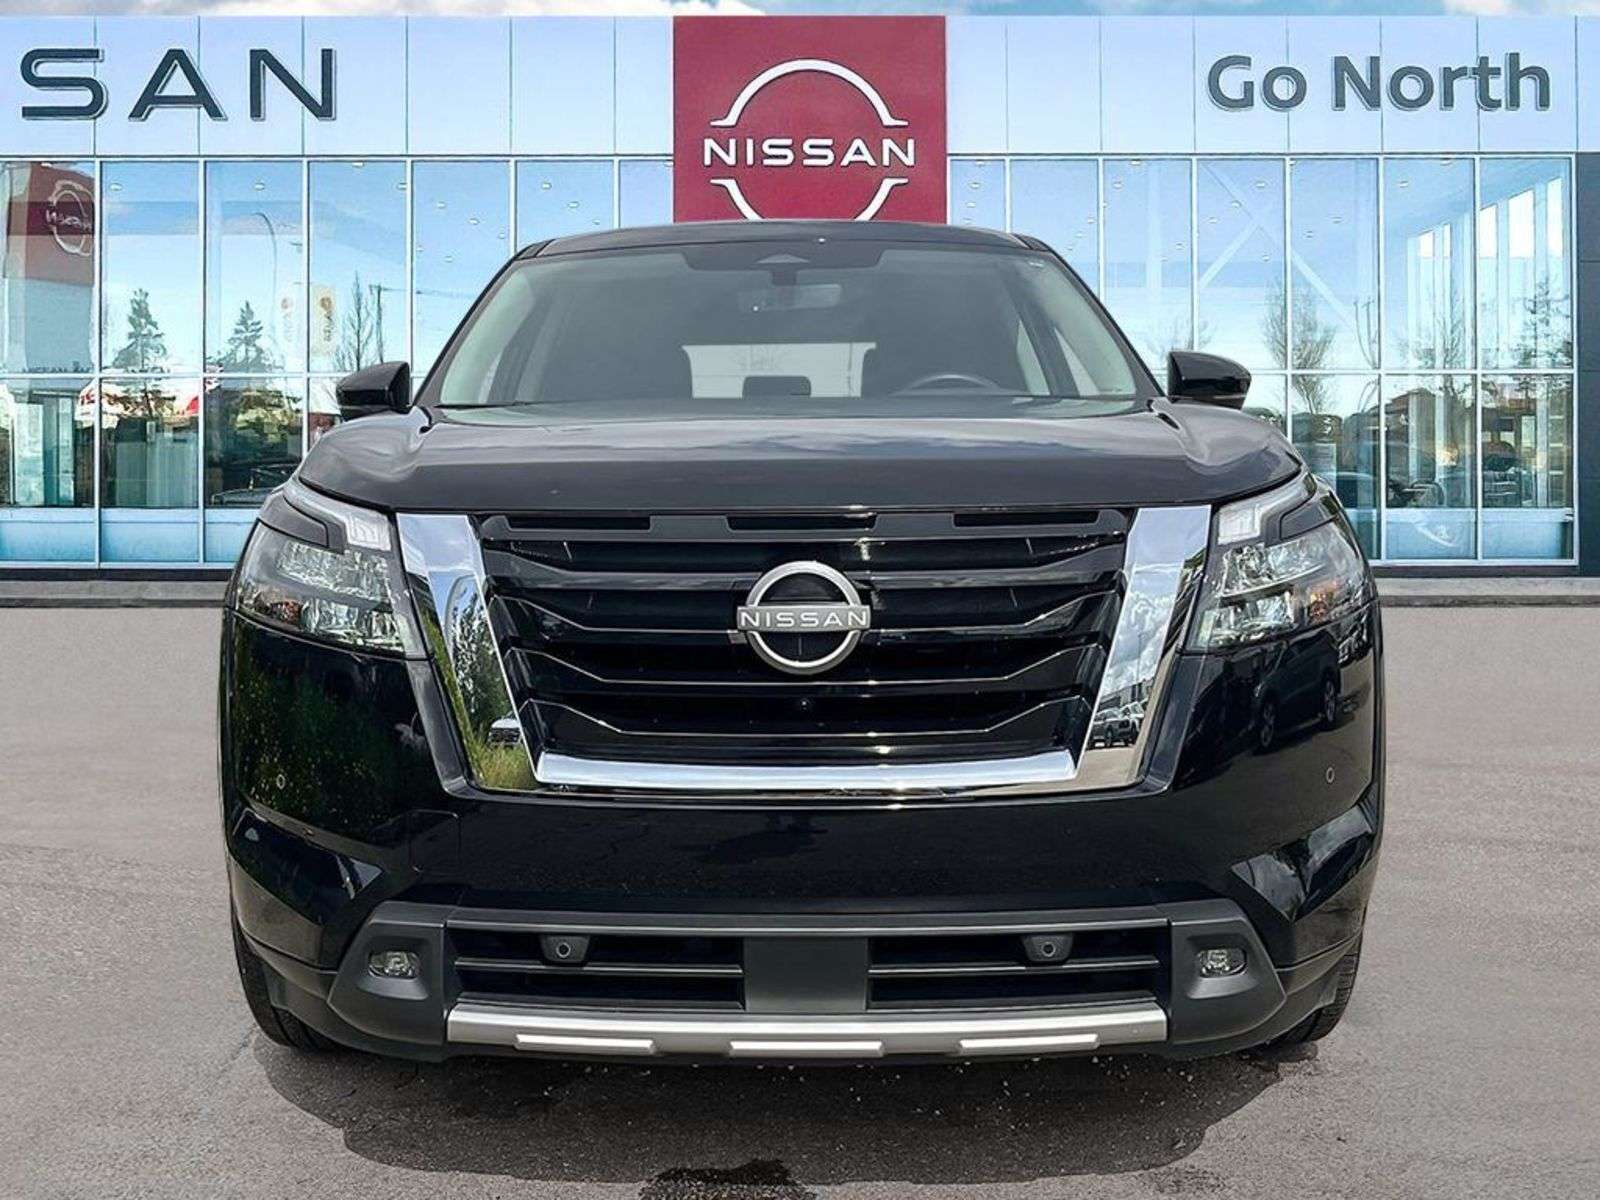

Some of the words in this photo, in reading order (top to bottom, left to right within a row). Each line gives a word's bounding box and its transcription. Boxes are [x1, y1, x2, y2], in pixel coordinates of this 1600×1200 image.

[20, 48, 336, 120] SAN
[1207, 54, 1307, 111] Go
[1331, 52, 1551, 111] North
[703, 137, 916, 167] NISSAN
[740, 610, 868, 628] NISSAN
